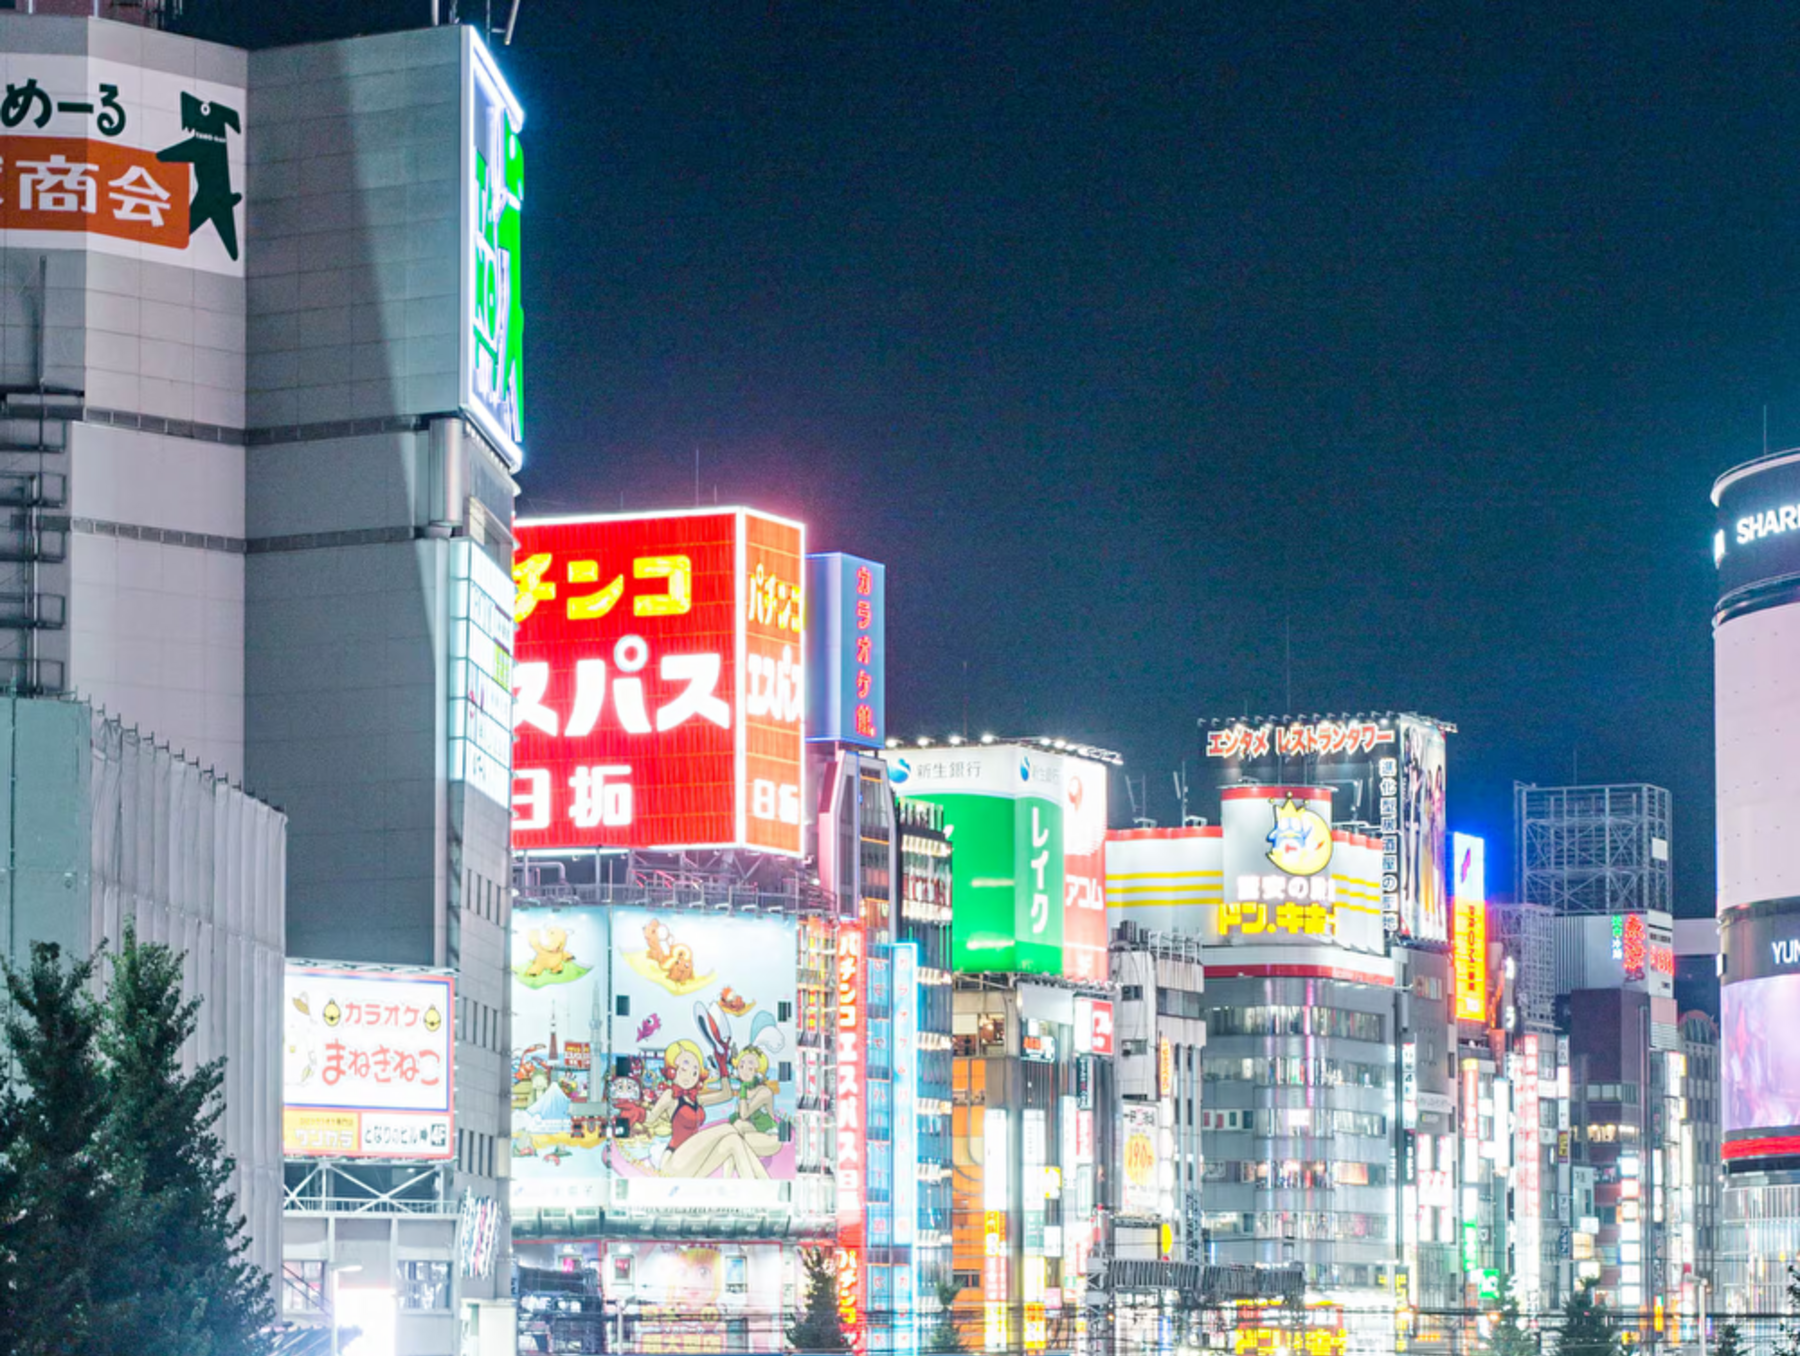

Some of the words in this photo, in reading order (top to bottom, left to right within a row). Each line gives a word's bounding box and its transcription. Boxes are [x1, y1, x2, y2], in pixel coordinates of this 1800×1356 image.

[0, 154, 171, 228] 商会
[1736, 502, 1800, 545] SHAR
[1206, 728, 1270, 758] エンタメ
[916, 759, 982, 779] 新生銀行
[1030, 806, 1049, 934] レイク
[345, 1001, 420, 1028] カラオケ
[322, 1038, 440, 1086] まねきねこ
